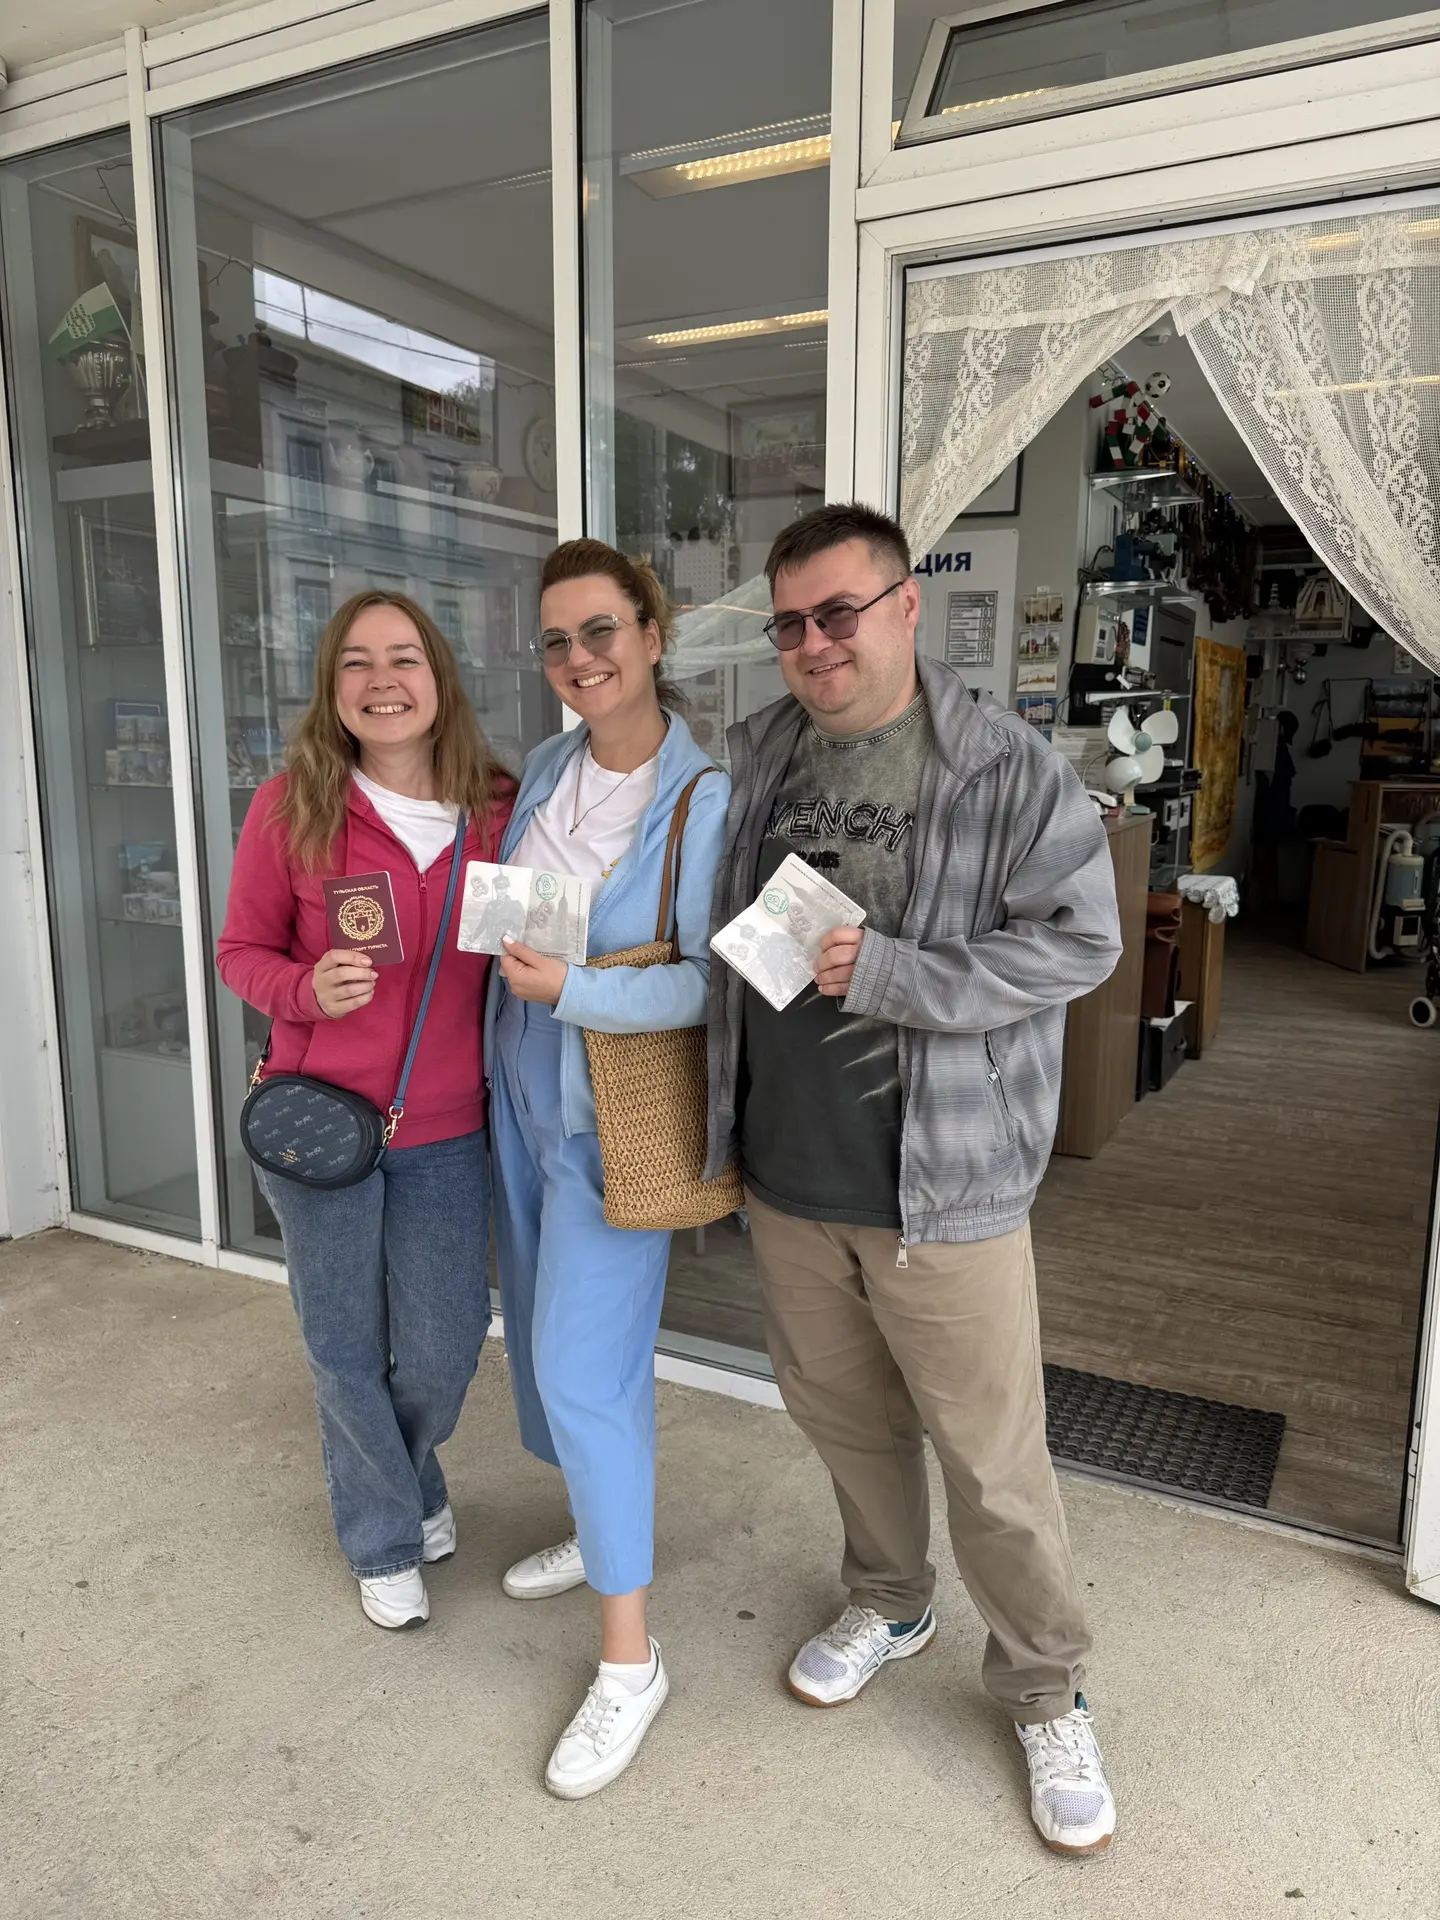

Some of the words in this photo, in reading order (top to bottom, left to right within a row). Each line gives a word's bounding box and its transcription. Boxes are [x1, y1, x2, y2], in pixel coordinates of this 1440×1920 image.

[915, 552, 971, 577] ЦИЯ
[980, 607, 993, 618] 101
[979, 619, 992, 629] 102
[978, 630, 991, 640] 103
[977, 641, 990, 651] 104
[976, 653, 990, 663] 112
